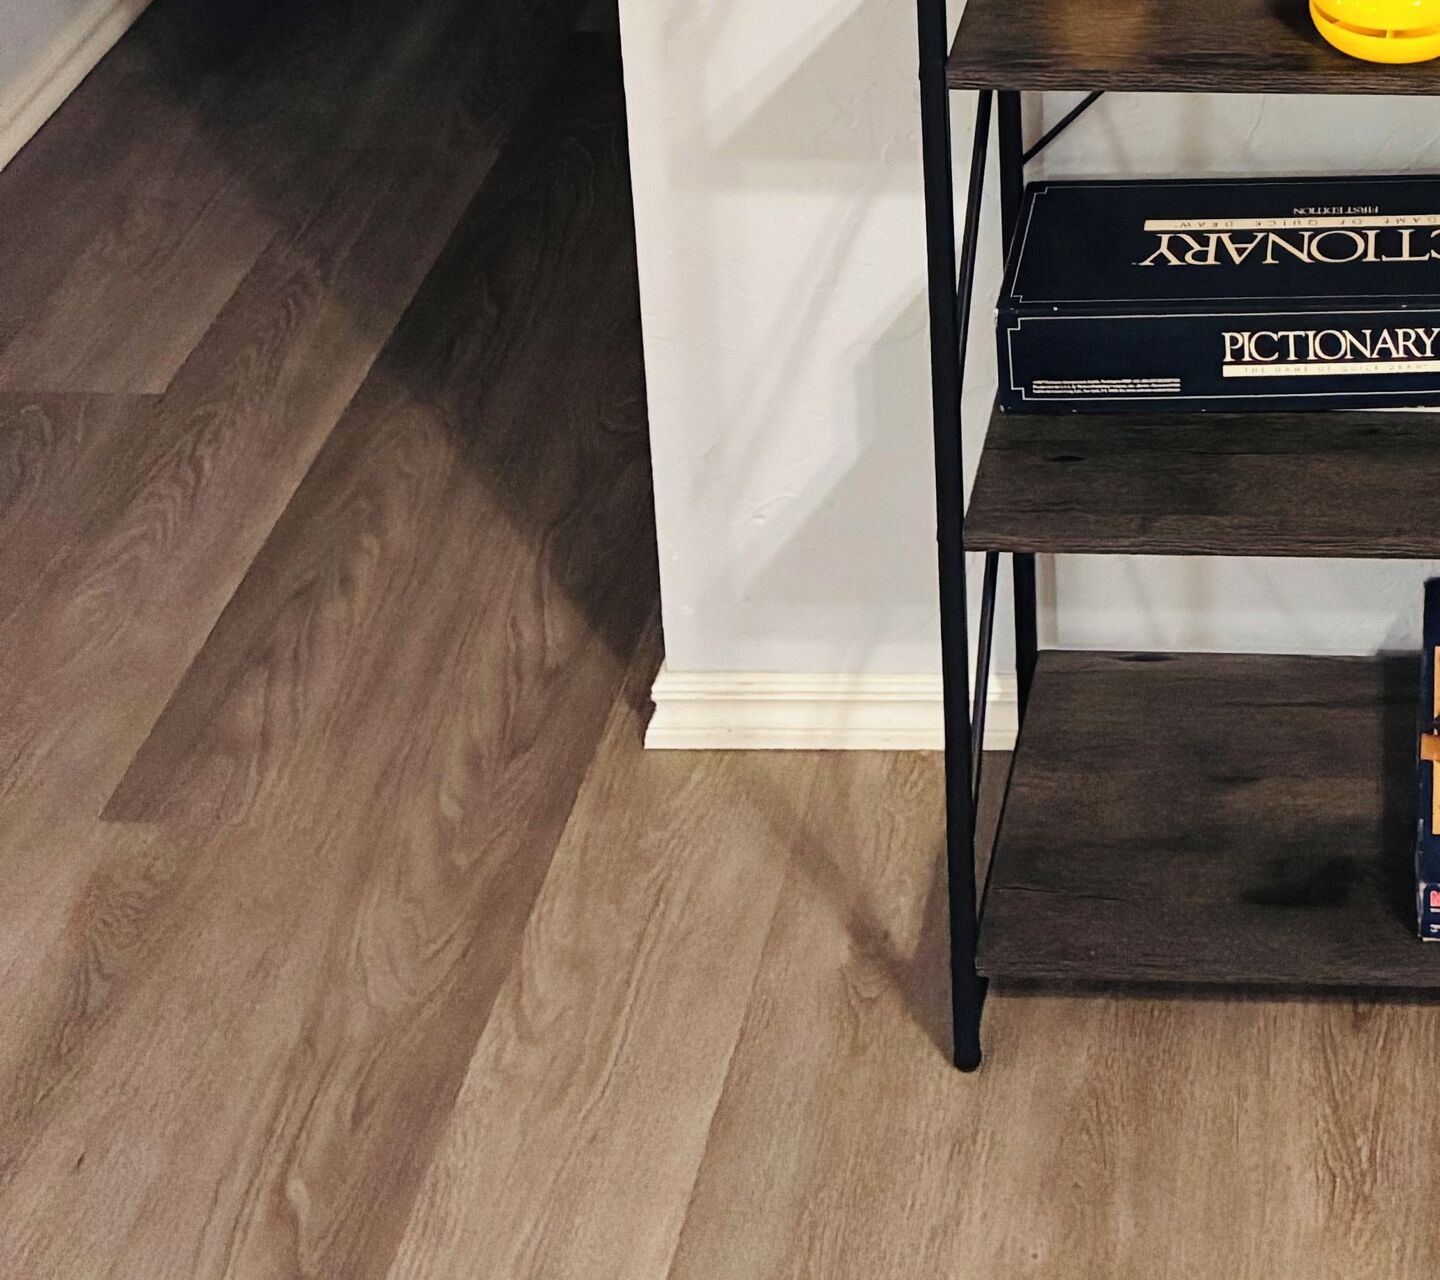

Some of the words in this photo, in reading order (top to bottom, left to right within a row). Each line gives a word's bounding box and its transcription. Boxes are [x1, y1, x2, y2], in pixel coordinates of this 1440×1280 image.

[1293, 206, 1344, 215] EDITION
[1345, 206, 1379, 215] FIRST
[1255, 219, 1319, 227] QUICK
[1384, 216, 1437, 224] GAME
